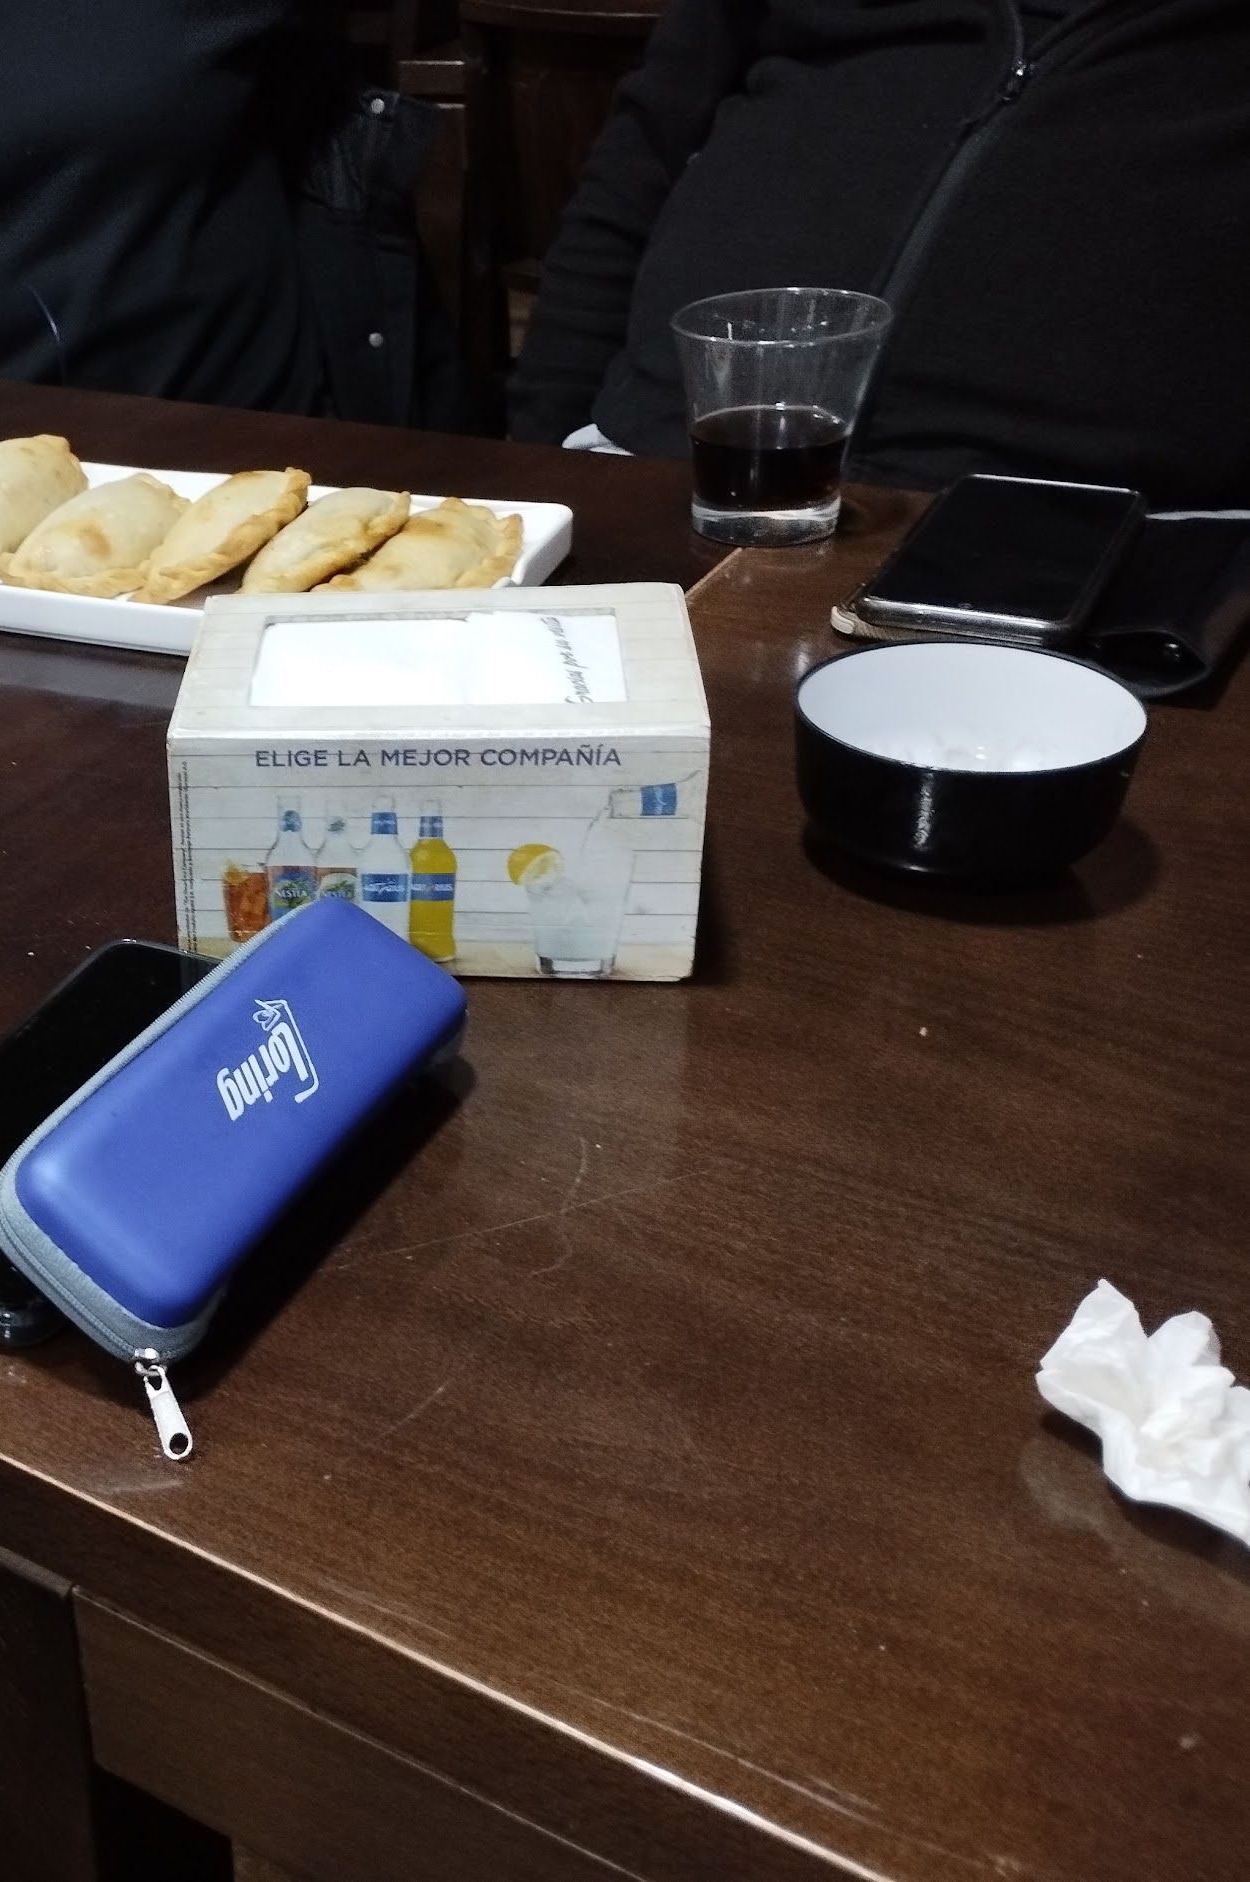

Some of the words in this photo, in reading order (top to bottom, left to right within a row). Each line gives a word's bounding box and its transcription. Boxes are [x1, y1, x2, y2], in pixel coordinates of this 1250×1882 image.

[255, 750, 328, 768] ELIGE
[338, 750, 371, 767] LA
[380, 749, 471, 767] MEJOR
[480, 743, 623, 767] COMPAÑÍA
